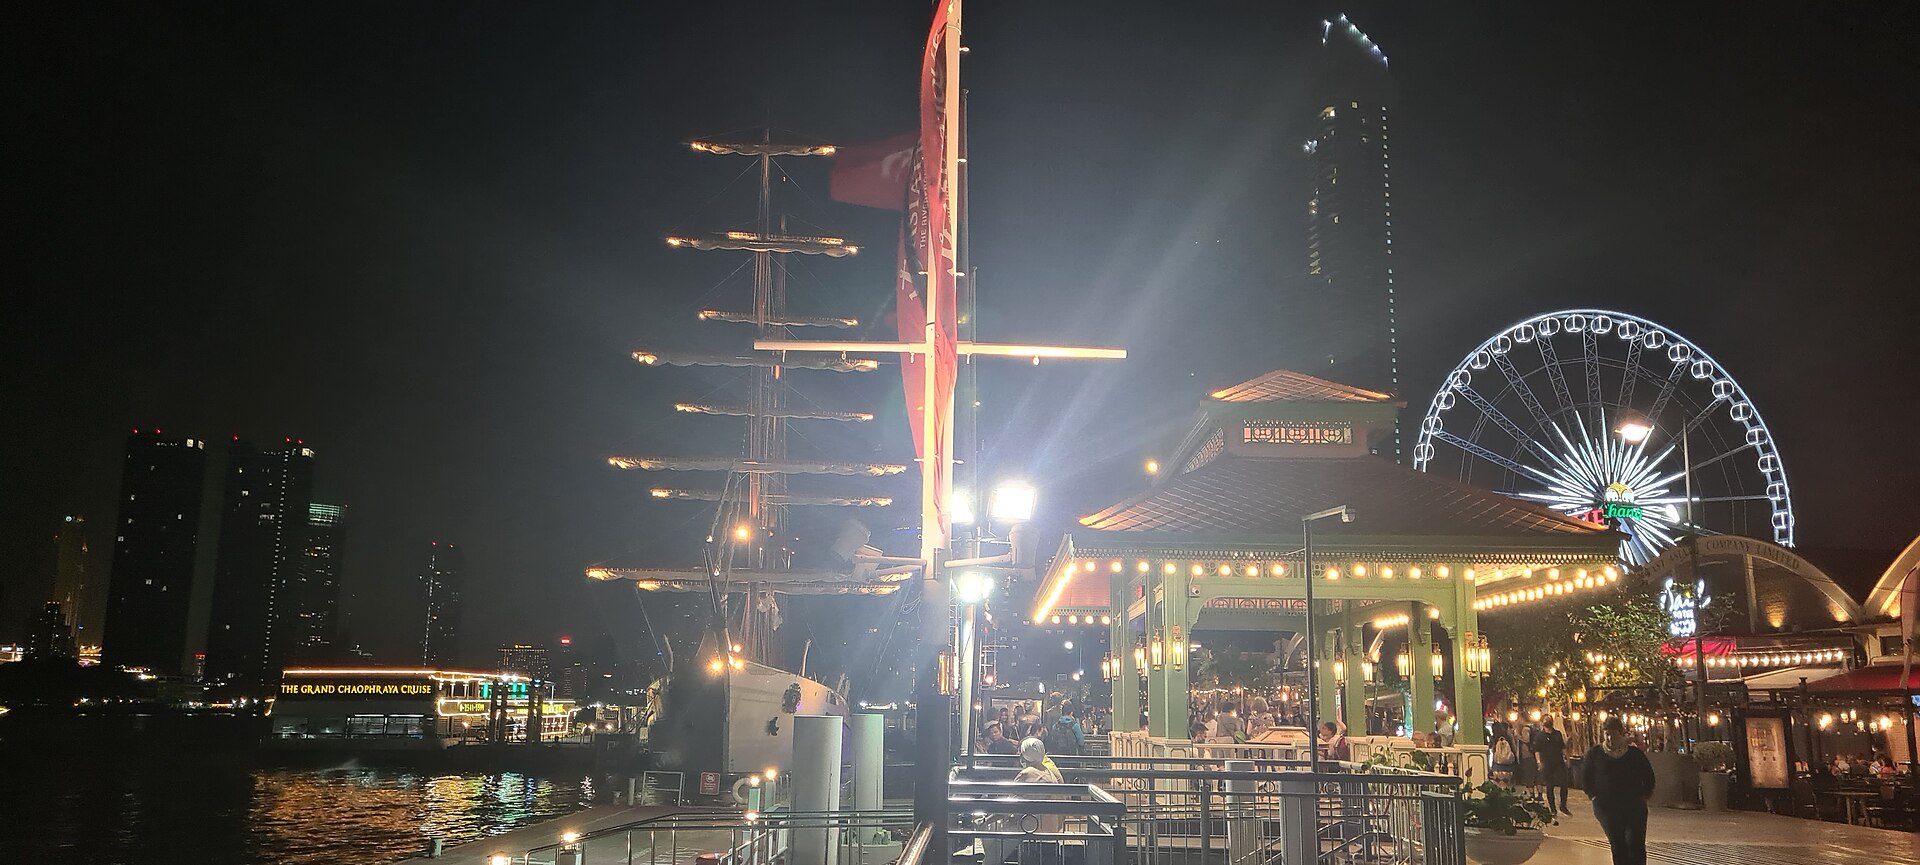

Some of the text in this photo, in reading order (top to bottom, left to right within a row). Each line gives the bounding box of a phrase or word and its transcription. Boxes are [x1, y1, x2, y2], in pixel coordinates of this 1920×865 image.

[919, 229, 927, 249] THE
[1706, 539, 1749, 552] COMPANY
[1756, 544, 1800, 569] LIMITED
[280, 684, 432, 695] THE GRAND CHAOPHRAYA CRUISE
